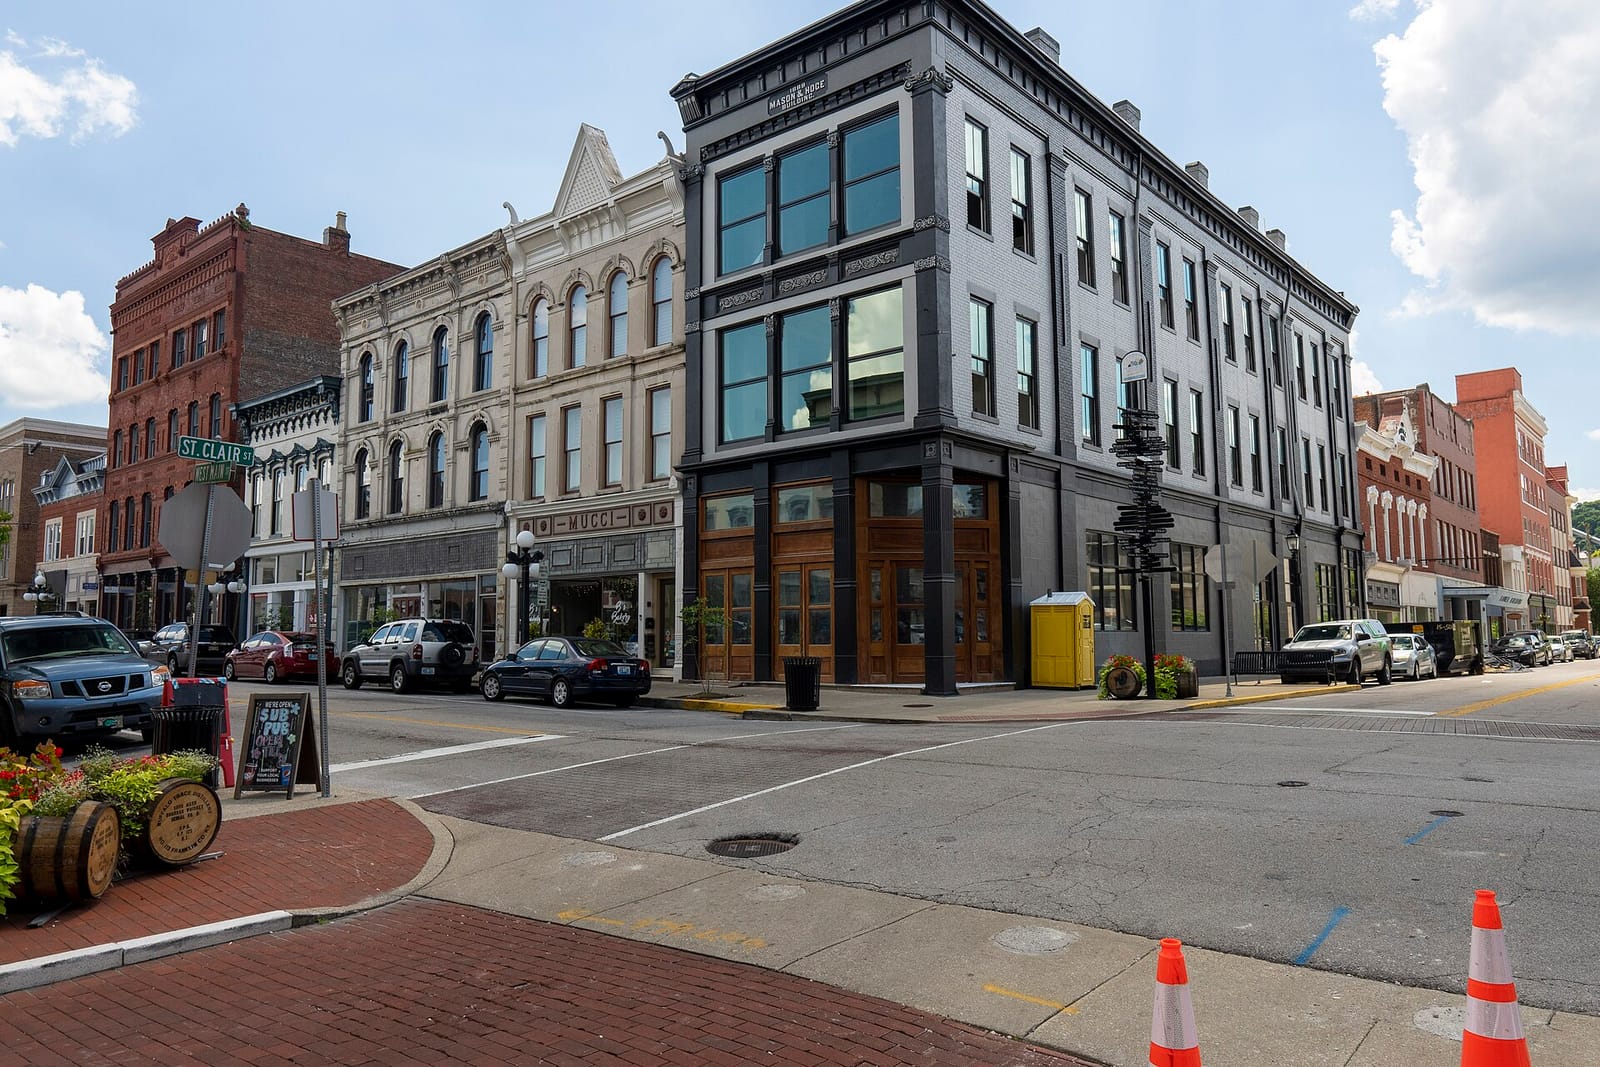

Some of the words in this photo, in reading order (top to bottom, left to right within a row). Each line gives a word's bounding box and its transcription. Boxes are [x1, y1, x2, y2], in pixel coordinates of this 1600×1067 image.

[769, 92, 796, 110] MASON
[797, 89, 804, 98] &
[182, 439, 200, 457] ST.
[202, 442, 240, 463] CLAIR
[242, 452, 251, 461] ST
[569, 511, 614, 530] MUCCI
[260, 708, 290, 722] SUB
[263, 722, 290, 736] PUB
